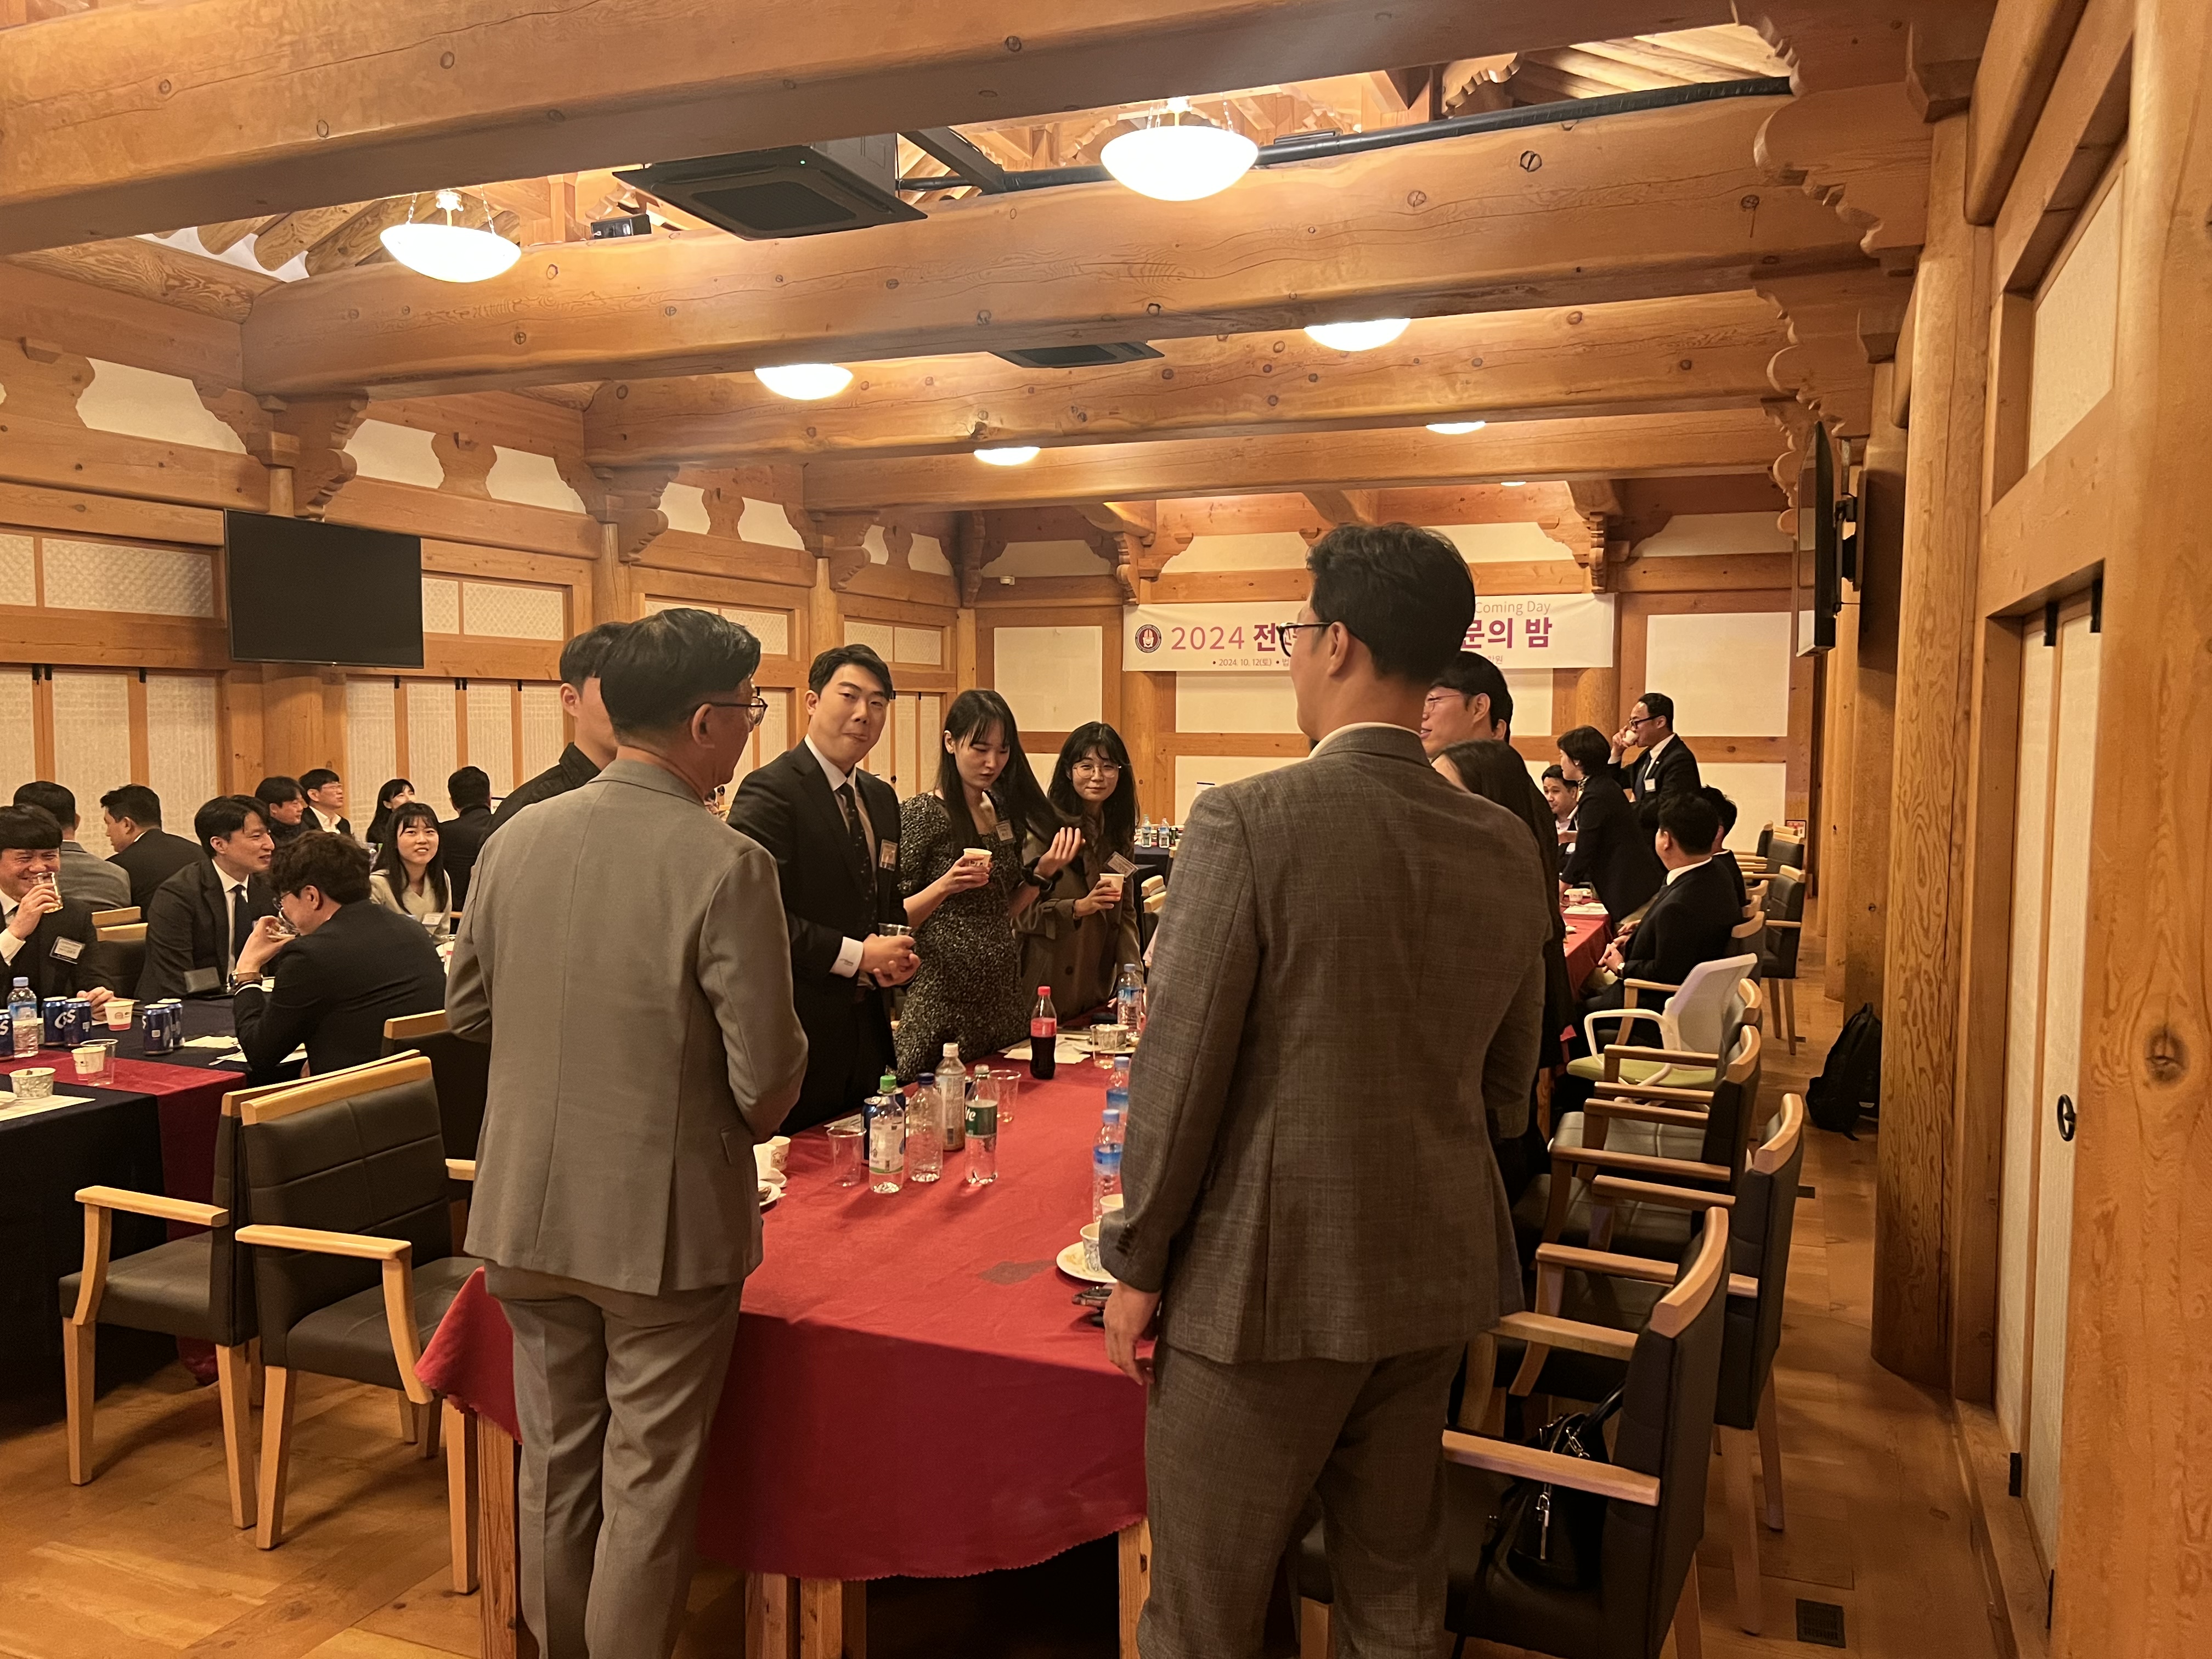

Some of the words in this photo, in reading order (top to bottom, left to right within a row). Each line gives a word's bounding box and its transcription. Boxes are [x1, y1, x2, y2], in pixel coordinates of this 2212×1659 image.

[1475, 601, 1523, 616] Coming
[1527, 601, 1551, 615] Day
[1171, 627, 1244, 650] 2024
[1526, 617, 1552, 648] 밤
